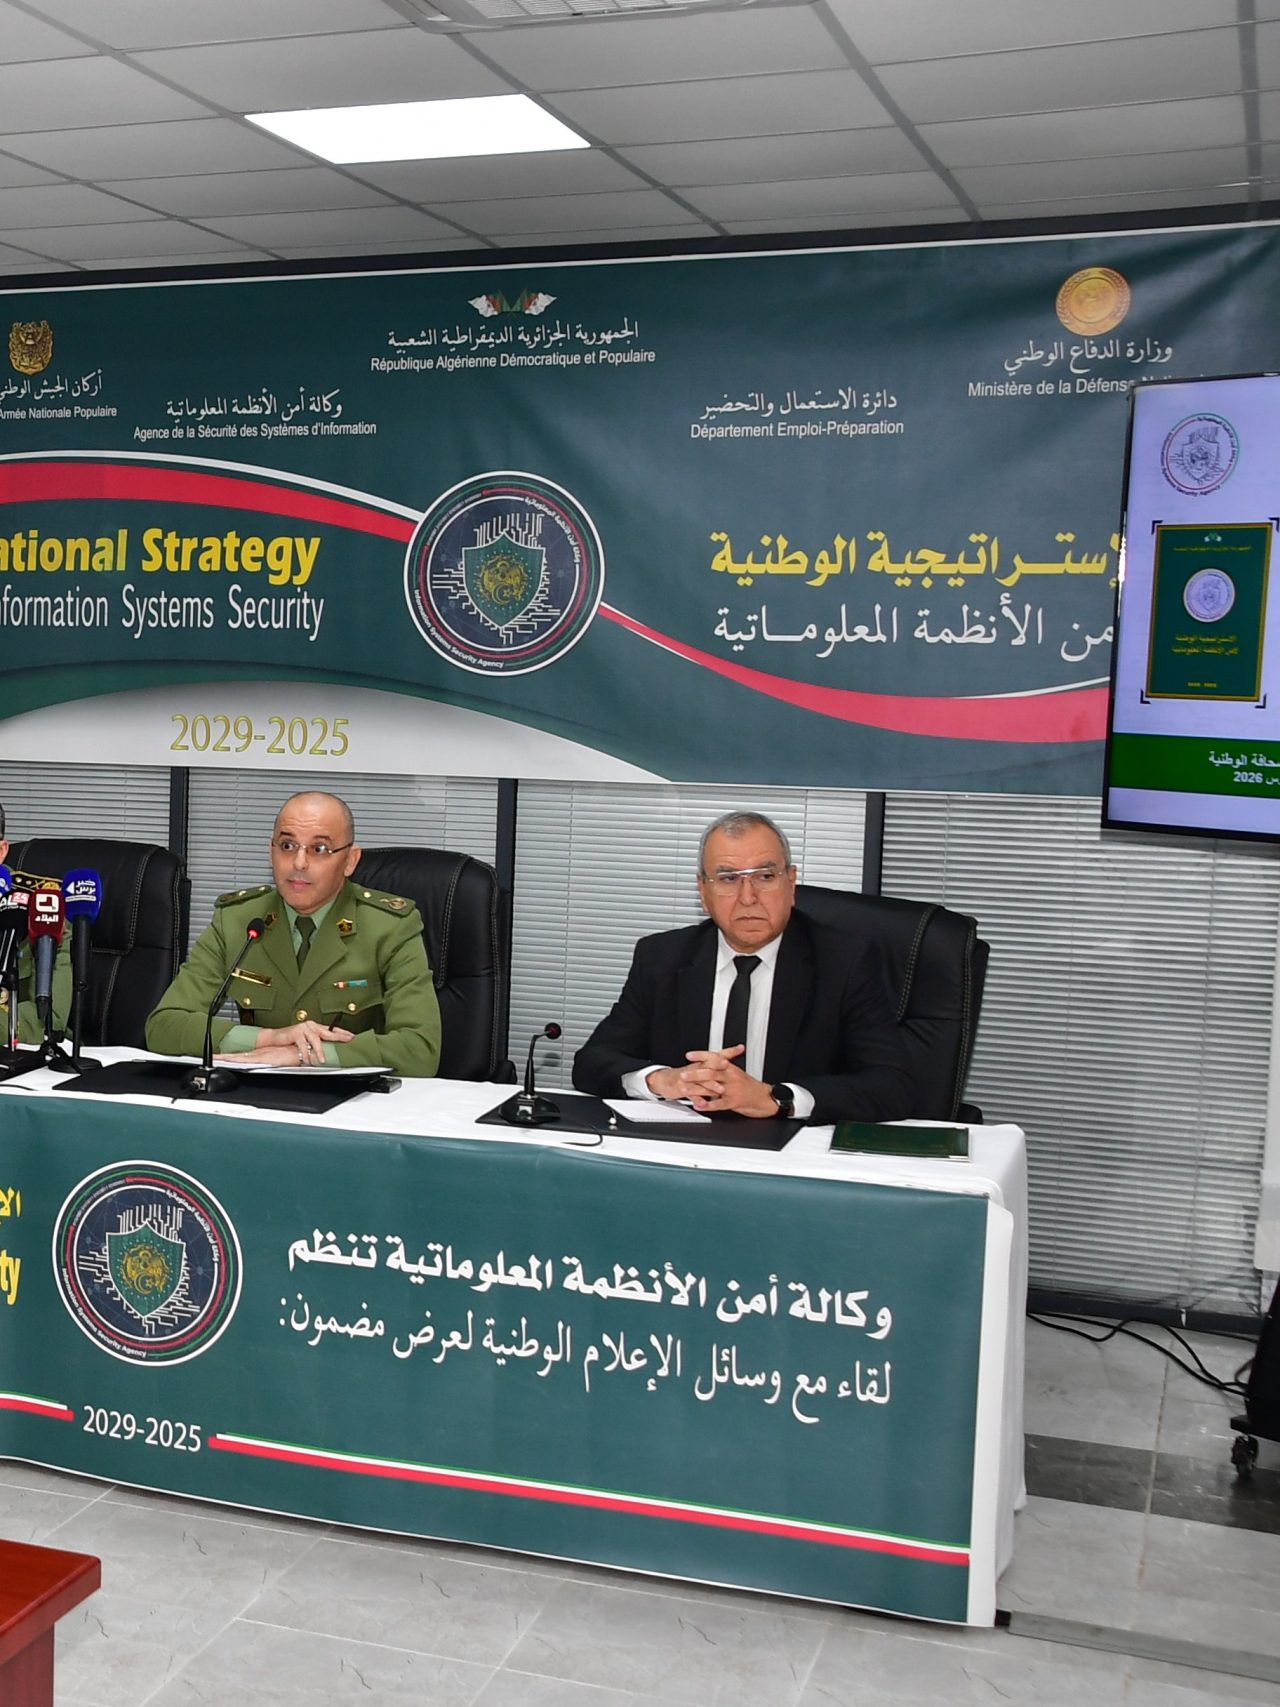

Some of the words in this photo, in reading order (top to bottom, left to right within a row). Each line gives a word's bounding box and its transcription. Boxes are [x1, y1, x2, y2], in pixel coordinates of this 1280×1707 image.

[387, 329, 438, 354] الشعبية
[441, 323, 513, 352] الديمقراطية
[517, 319, 570, 350] الجزائرية
[575, 316, 639, 346] الجمهورية
[371, 356, 434, 374] République
[436, 353, 497, 374] Algérienne
[500, 351, 581, 370] Démocratique
[584, 352, 597, 365] et
[599, 349, 656, 367] Populaire
[1004, 340, 1064, 376] الوطني
[1069, 340, 1120, 374] الدفاع
[1126, 338, 1173, 364] وزارة
[34, 375, 68, 400] الجيش
[72, 369, 103, 397] أركان
[780, 386, 857, 414] الاستعمال
[968, 380, 1034, 397] Ministère
[1036, 380, 1055, 395] de
[1058, 379, 1071, 395] la
[29, 406, 71, 420] Nationale
[74, 405, 117, 420] Populaire
[166, 396, 228, 423] المعلوماتية
[231, 387, 277, 416] الأنظمة
[281, 386, 304, 421] أمن
[309, 389, 342, 418] وكالة
[700, 392, 775, 420] والتحضير
[861, 389, 898, 415] دائرة
[134, 427, 170, 442] Agence
[172, 426, 185, 439] de
[186, 426, 196, 438] la
[197, 424, 238, 438] Sécurité
[240, 424, 259, 437] des
[261, 422, 310, 440] Systèmes
[312, 420, 377, 436] d'Information
[690, 423, 774, 441] Département
[777, 420, 905, 439] Emploi-Préparation
[141, 526, 322, 586] Strategy
[710, 531, 856, 588] الوطنية
[867, 530, 1120, 588] ستراتيجية
[121, 583, 215, 640] Systems
[228, 583, 325, 641] Security
[913, 592, 1043, 646] الأنظمة
[713, 603, 898, 658] المعلوماتية
[170, 713, 350, 756] 2029-2025
[1208, 750, 1247, 769] الوطنية
[1233, 771, 1263, 784] 2026
[288, 1227, 379, 1273] تنظم
[385, 1234, 554, 1293] المعلوماتية
[562, 1254, 707, 1309] الأنظمة
[716, 1272, 779, 1324] أمن
[788, 1281, 893, 1341] وكالة
[391, 1309, 474, 1365] لعرض
[482, 1316, 572, 1378] الوطنية
[583, 1331, 682, 1393] الإعلام
[694, 1343, 782, 1405] وسائل
[791, 1373, 828, 1425] مع
[837, 1360, 892, 1405] لقاء
[82, 1404, 202, 1453] 2029-2025
